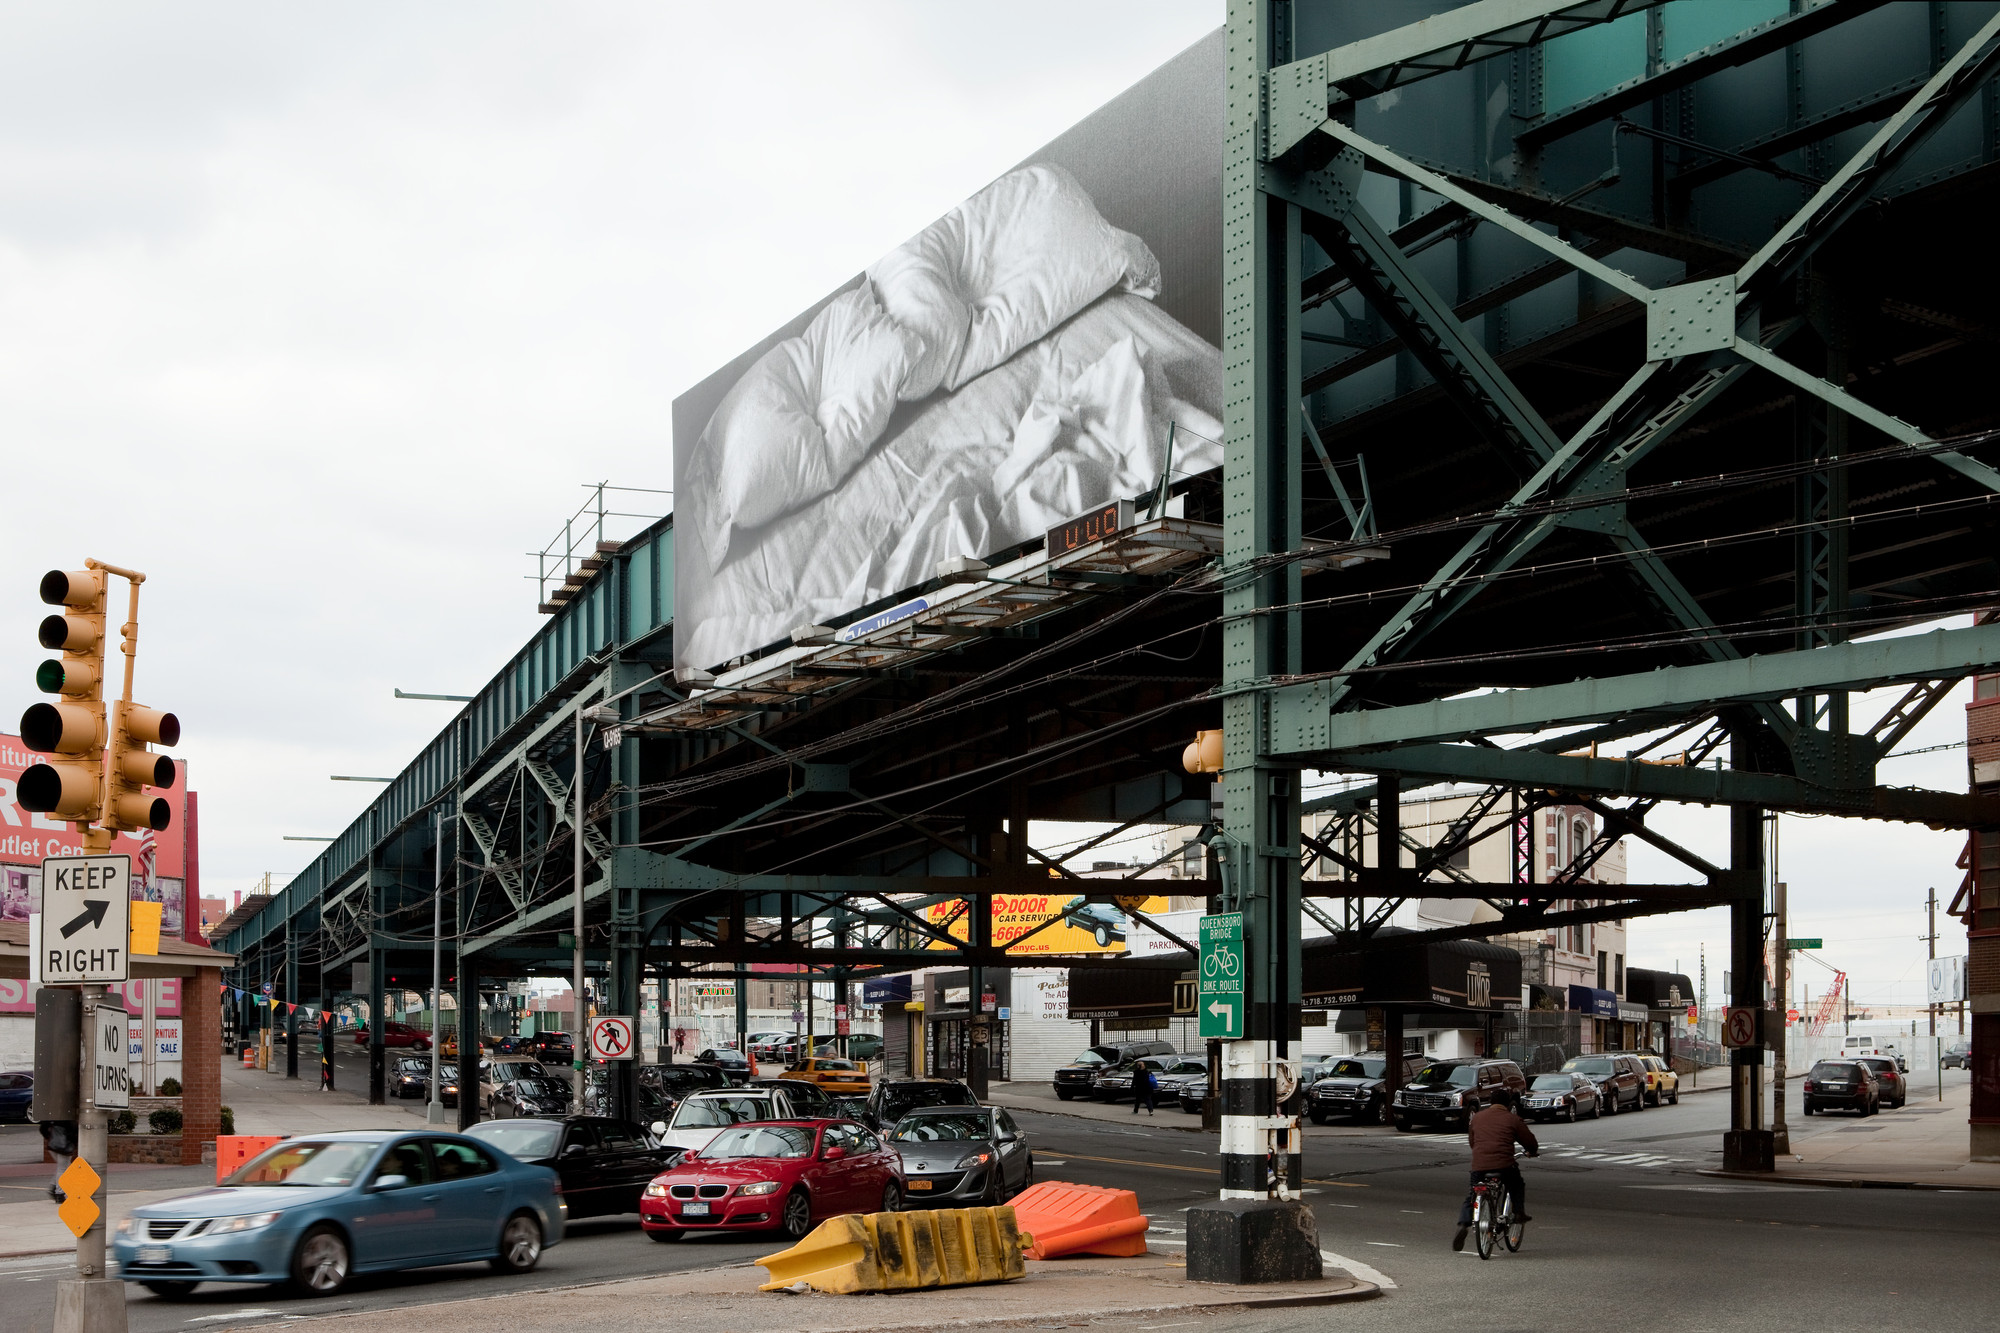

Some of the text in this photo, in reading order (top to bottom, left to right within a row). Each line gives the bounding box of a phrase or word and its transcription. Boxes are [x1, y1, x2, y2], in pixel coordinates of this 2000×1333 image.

[55, 866, 116, 890] KEEP
[1007, 897, 1048, 914] DOOR
[998, 915, 1017, 923] CAR
[1200, 916, 1241, 930] QUEENSBORO
[1209, 928, 1232, 939] BRIDGE
[49, 948, 120, 973] RIGHT
[1203, 980, 1240, 991] BIKE ROUTE
[1467, 970, 1491, 1007] LUXOR
[702, 987, 732, 996] AUTO
[1044, 1002, 1057, 1010] TOY
[104, 1024, 119, 1053] NO
[156, 1028, 178, 1039] RNITURE
[973, 1029, 987, 1039] 25
[160, 1043, 178, 1054] SALE
[96, 1064, 127, 1092] TURNS
